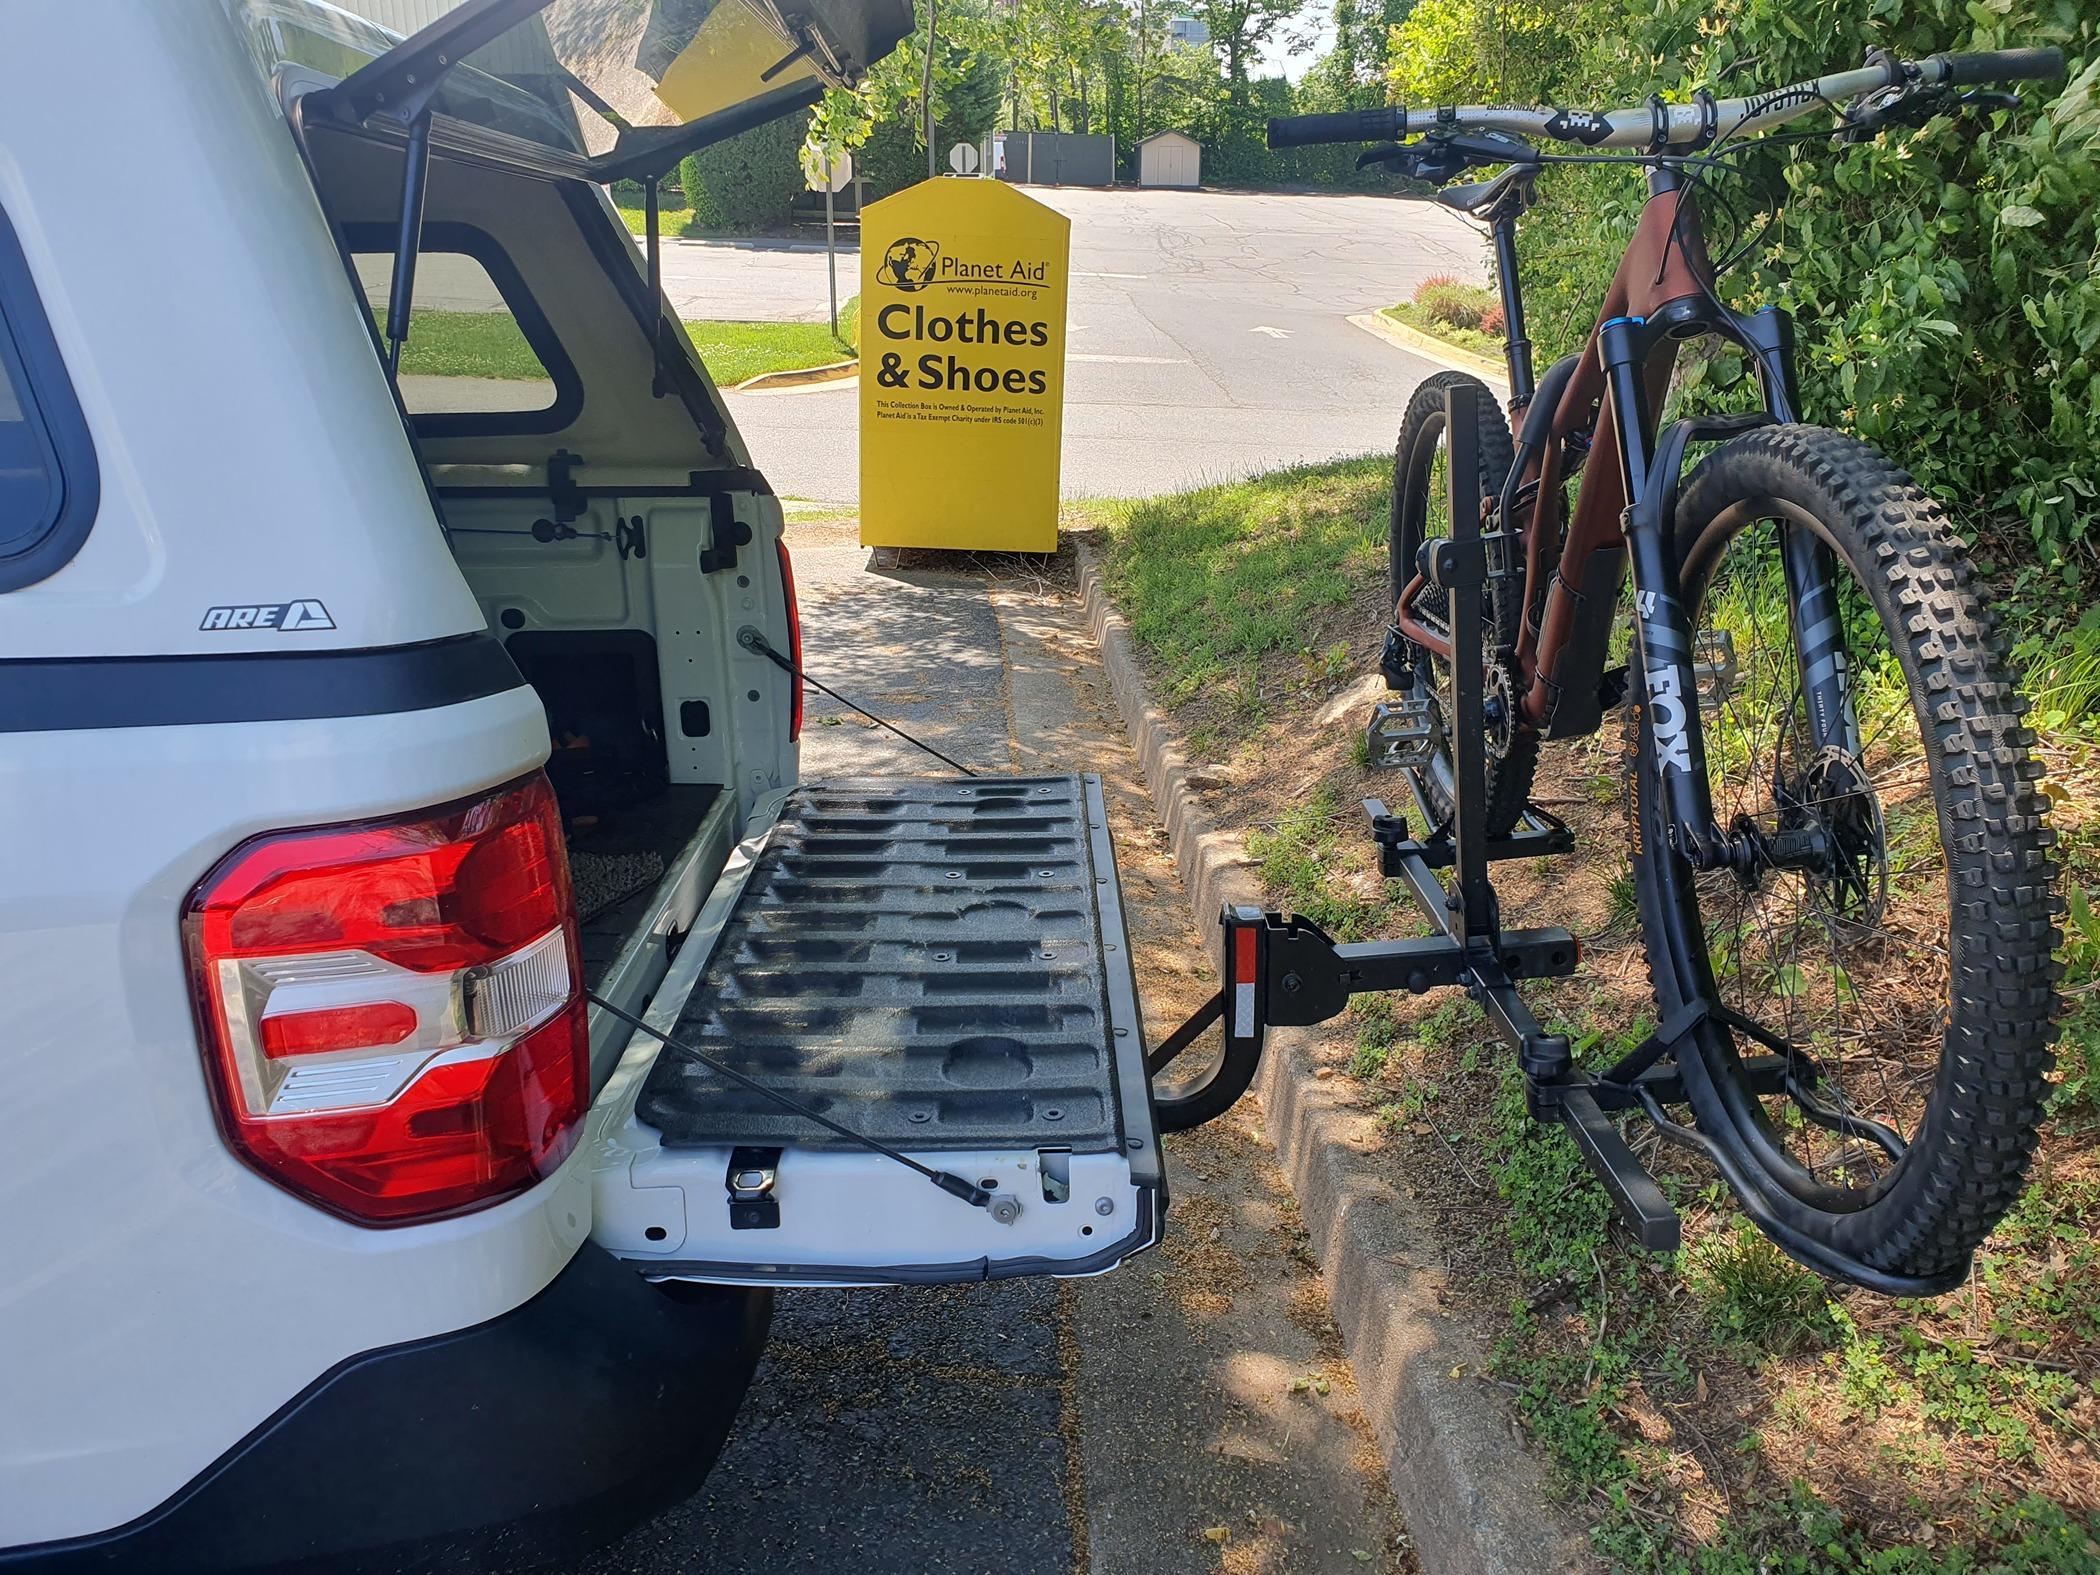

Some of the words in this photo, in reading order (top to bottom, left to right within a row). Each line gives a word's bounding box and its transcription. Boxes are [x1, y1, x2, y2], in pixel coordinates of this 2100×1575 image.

[1740, 79, 1820, 119] JOYSTICK
[942, 257, 1003, 279] Planet
[947, 286, 1038, 301] www.planetaid.org
[877, 303, 1049, 347] Clothes
[876, 352, 911, 389] &
[918, 354, 1047, 395] Shoes
[876, 400, 889, 408] This
[890, 401, 920, 410] Collection
[920, 402, 932, 410] Box
[932, 403, 938, 411] is
[938, 403, 960, 412] Owned
[960, 404, 966, 412] &
[966, 404, 993, 414] Operated
[994, 405, 1002, 414] by
[1002, 406, 1021, 415] Planet
[1021, 407, 1034, 416] Aid,
[1034, 408, 1045, 416] Inc.
[876, 411, 896, 419] Planet
[895, 411, 906, 419] Aid
[906, 412, 912, 420] is
[917, 412, 927, 421] Tax
[928, 413, 951, 423] Exempt
[951, 414, 973, 424] Charity
[973, 416, 991, 424] under
[991, 416, 1002, 425] IRS
[1003, 417, 1017, 425] code
[1017, 418, 1044, 427] 501(c)(3)
[201, 606, 280, 630] ARE
[1815, 691, 1825, 719] THIRTY
[1644, 664, 1692, 777] FOX
[1629, 771, 1643, 855] KRYPTOTAL
